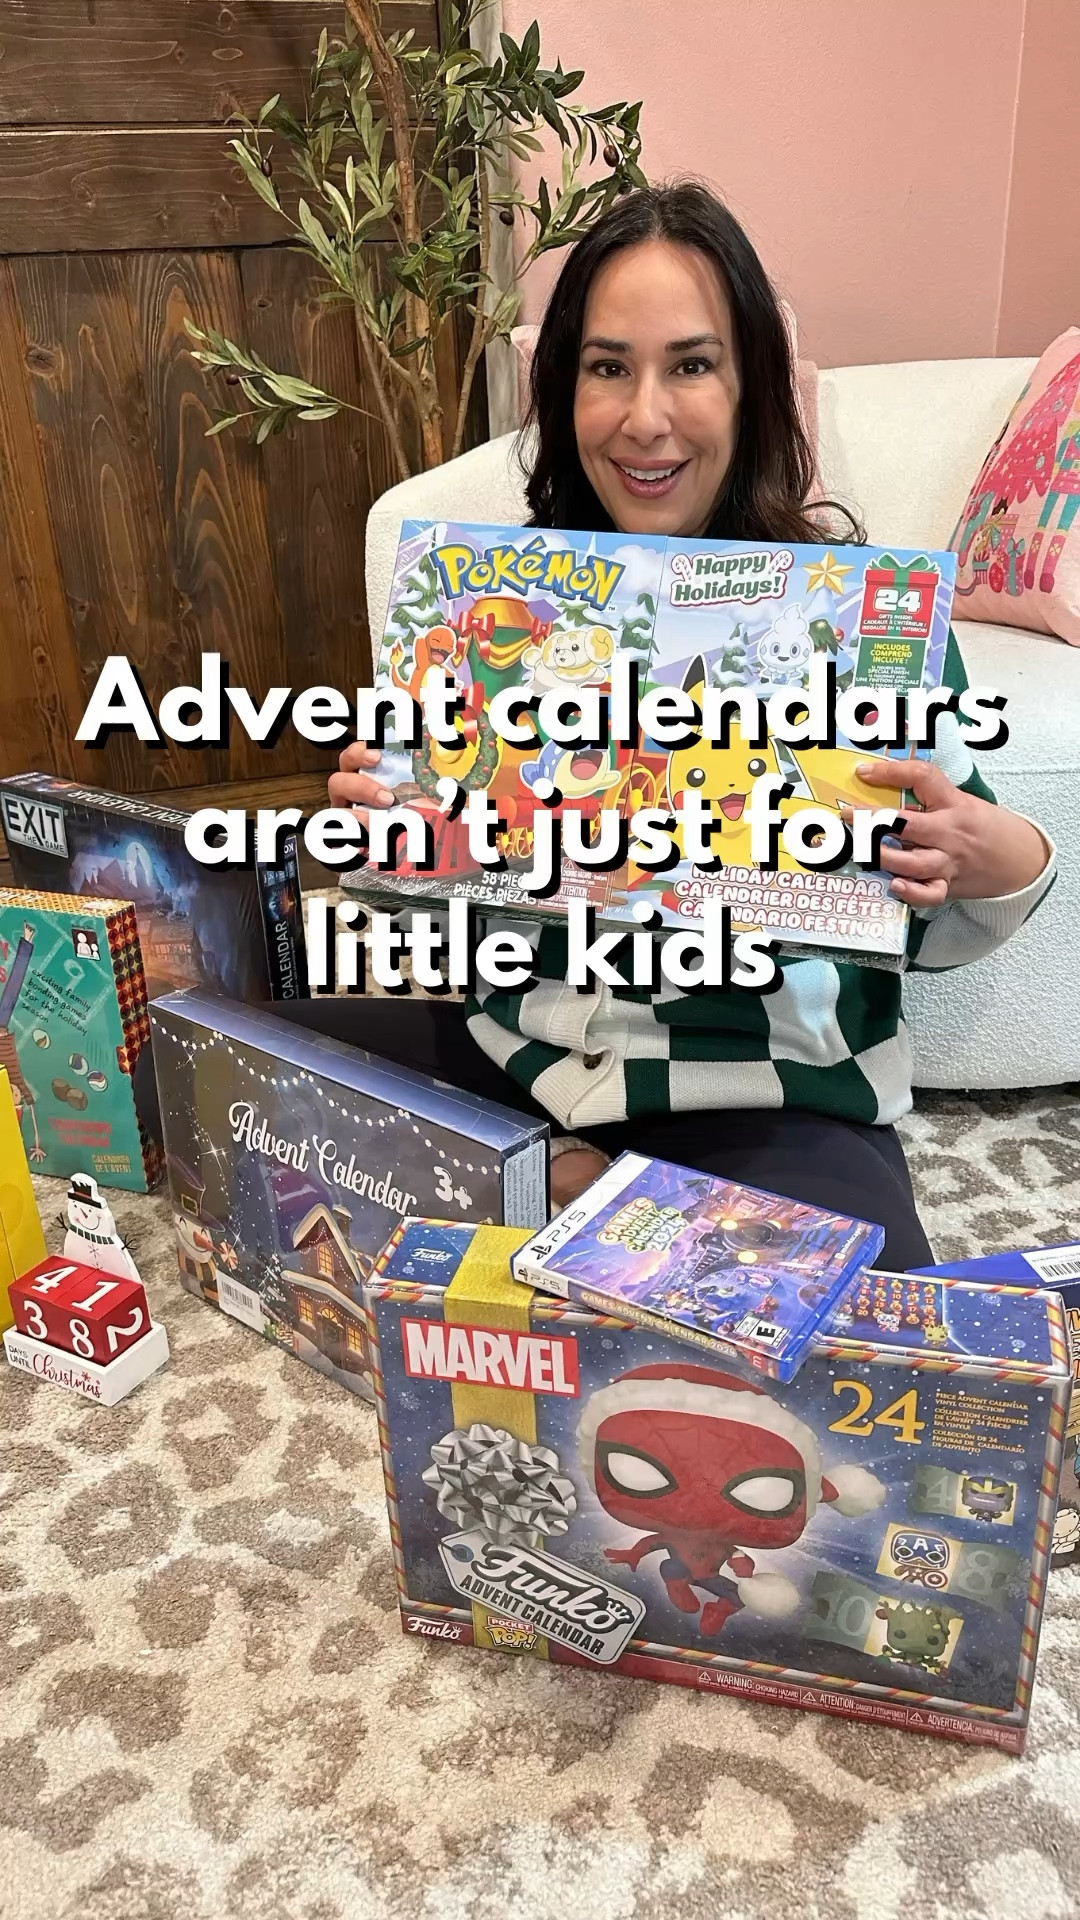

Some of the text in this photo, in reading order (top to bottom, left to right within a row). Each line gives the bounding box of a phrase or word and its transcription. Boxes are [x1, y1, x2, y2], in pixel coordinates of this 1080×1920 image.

[696, 552, 767, 578] Happy
[675, 575, 782, 602] Holidays!
[874, 588, 921, 613] 24
[870, 650, 912, 658] COMPREND
[874, 643, 911, 651] INCLUDES
[872, 656, 904, 664] INCLUYE
[68, 790, 146, 813] CALENDAR
[4, 799, 60, 847] EXIT
[23, 834, 65, 853] THE GAME
[454, 881, 493, 899] PIÈCES
[482, 871, 497, 885] 58
[777, 872, 885, 898] CALENDAR
[560, 885, 588, 898] ATTENTION
[675, 881, 897, 919] CALENDRIER DES FÊTES
[679, 900, 885, 938] CANDARIO FESTIVO
[276, 920, 295, 1000] CALENDAR
[28, 978, 86, 1021] bonding games
[32, 968, 91, 1012] exciting family
[22, 1002, 49, 1023] season
[25, 991, 88, 1037] for the holiday
[228, 1101, 310, 1173] Advent
[312, 1134, 418, 1217] Calendar
[433, 1166, 473, 1211] 3+
[546, 1210, 587, 1243] PS5
[600, 1197, 653, 1244] GAMES
[621, 1207, 660, 1242] ADVENT
[629, 1206, 681, 1252] CALENDAR
[646, 1216, 689, 1251] 2024
[411, 1247, 454, 1262] Funko
[31, 1265, 120, 1312] 4 1
[530, 1273, 561, 1291] PS5
[24, 1300, 95, 1359] 3 8
[581, 1291, 615, 1310] GAMES
[616, 1306, 656, 1326] ADVENT
[656, 1318, 708, 1344] CALENDAR
[756, 1326, 776, 1338] E
[8, 1344, 29, 1360] DAYS
[9, 1354, 32, 1370] UNTIL
[405, 1322, 576, 1394] MARVEL
[33, 1353, 103, 1399] Christmas
[828, 1380, 925, 1444] 24
[936, 1392, 1029, 1410] PIECE ADVENT CALENDAR
[958, 1402, 1006, 1413] COLLECTION
[934, 1408, 1029, 1426] COLLECTION CALENDRIER
[945, 1422, 971, 1430] VINYLE
[946, 1416, 976, 1424] L'AVENT
[932, 1429, 976, 1440] COLECCIÓN
[989, 1436, 998, 1444] 24
[932, 1436, 962, 1444] FIGURAS
[978, 1442, 1025, 1454] CALENDARIO
[943, 1444, 981, 1454] ADVIENTO
[471, 1542, 633, 1634] Funko
[460, 1574, 605, 1657] ADVENT CALENDAR
[490, 1617, 533, 1632] POCKET
[407, 1616, 461, 1640] Funko
[488, 1626, 538, 1650] POP!
[716, 1673, 756, 1690] WARNING:
[756, 1684, 778, 1694] CHOKING
[778, 1689, 798, 1698] HAZARD
[820, 1693, 856, 1710] ATTENTION:
[928, 1714, 975, 1733] ADVERTENCIA:
